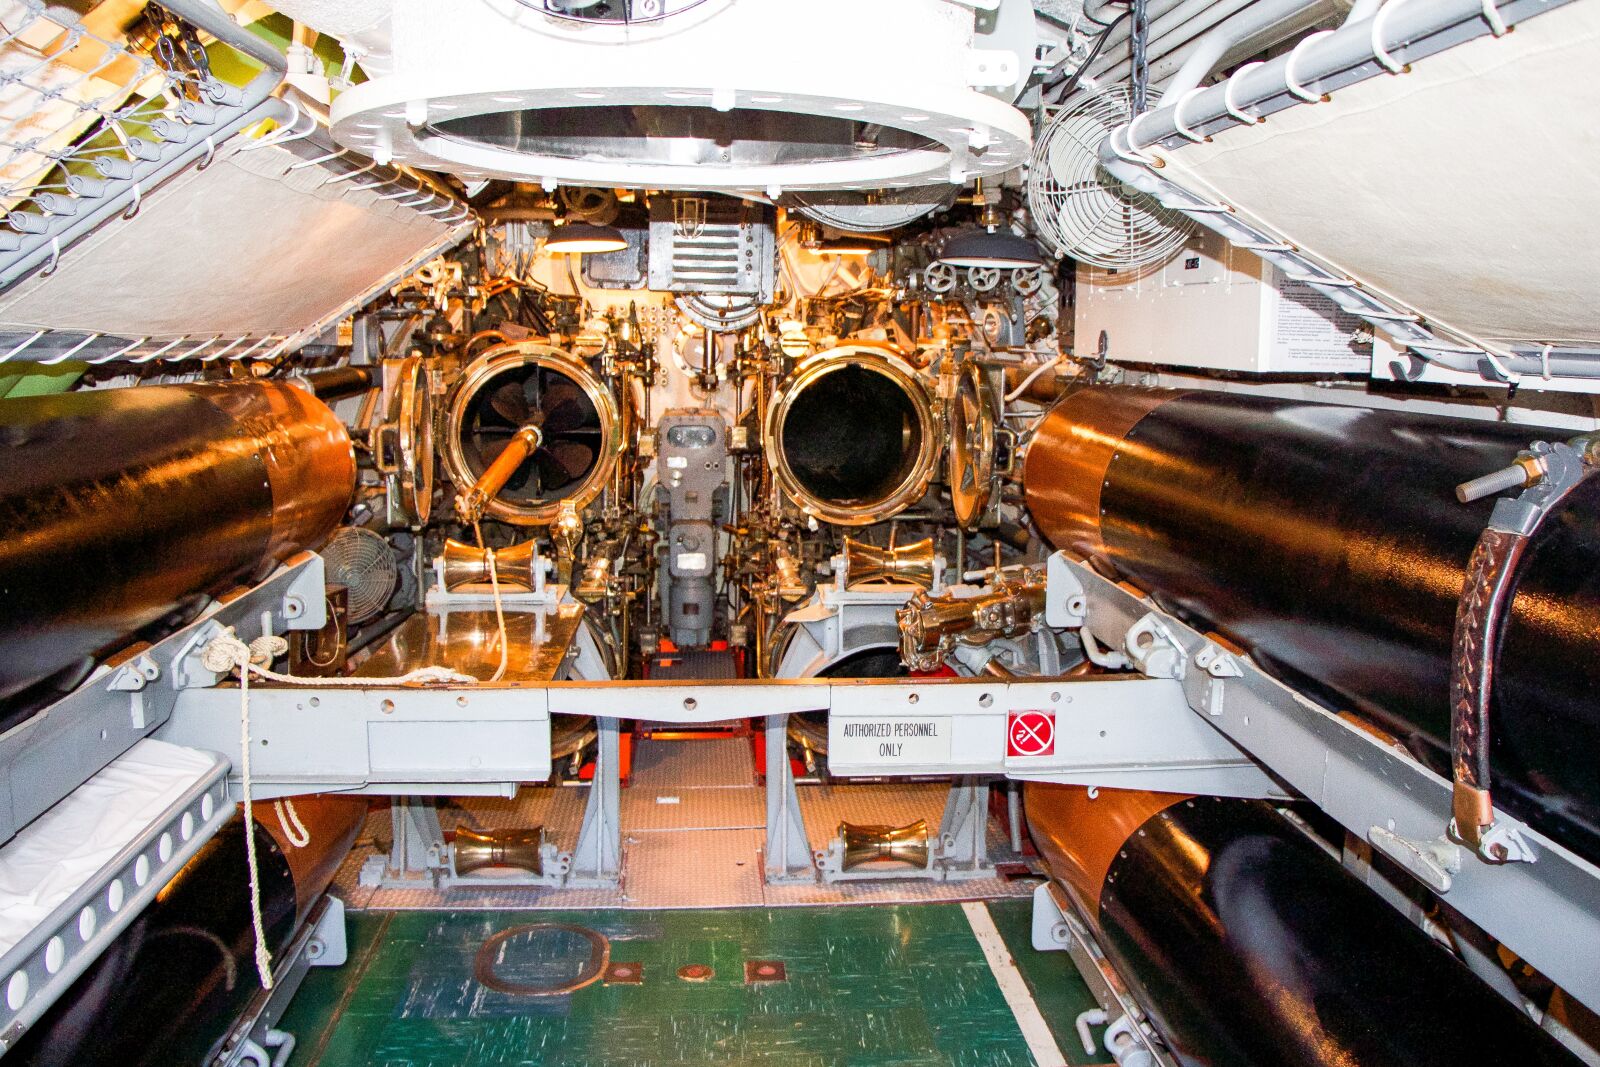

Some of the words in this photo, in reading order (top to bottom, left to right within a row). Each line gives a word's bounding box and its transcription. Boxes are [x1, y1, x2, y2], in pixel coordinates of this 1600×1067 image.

[844, 723, 891, 737] AUTHORIZED
[894, 723, 938, 737] PERSONNEL
[879, 743, 903, 757] ONLY
